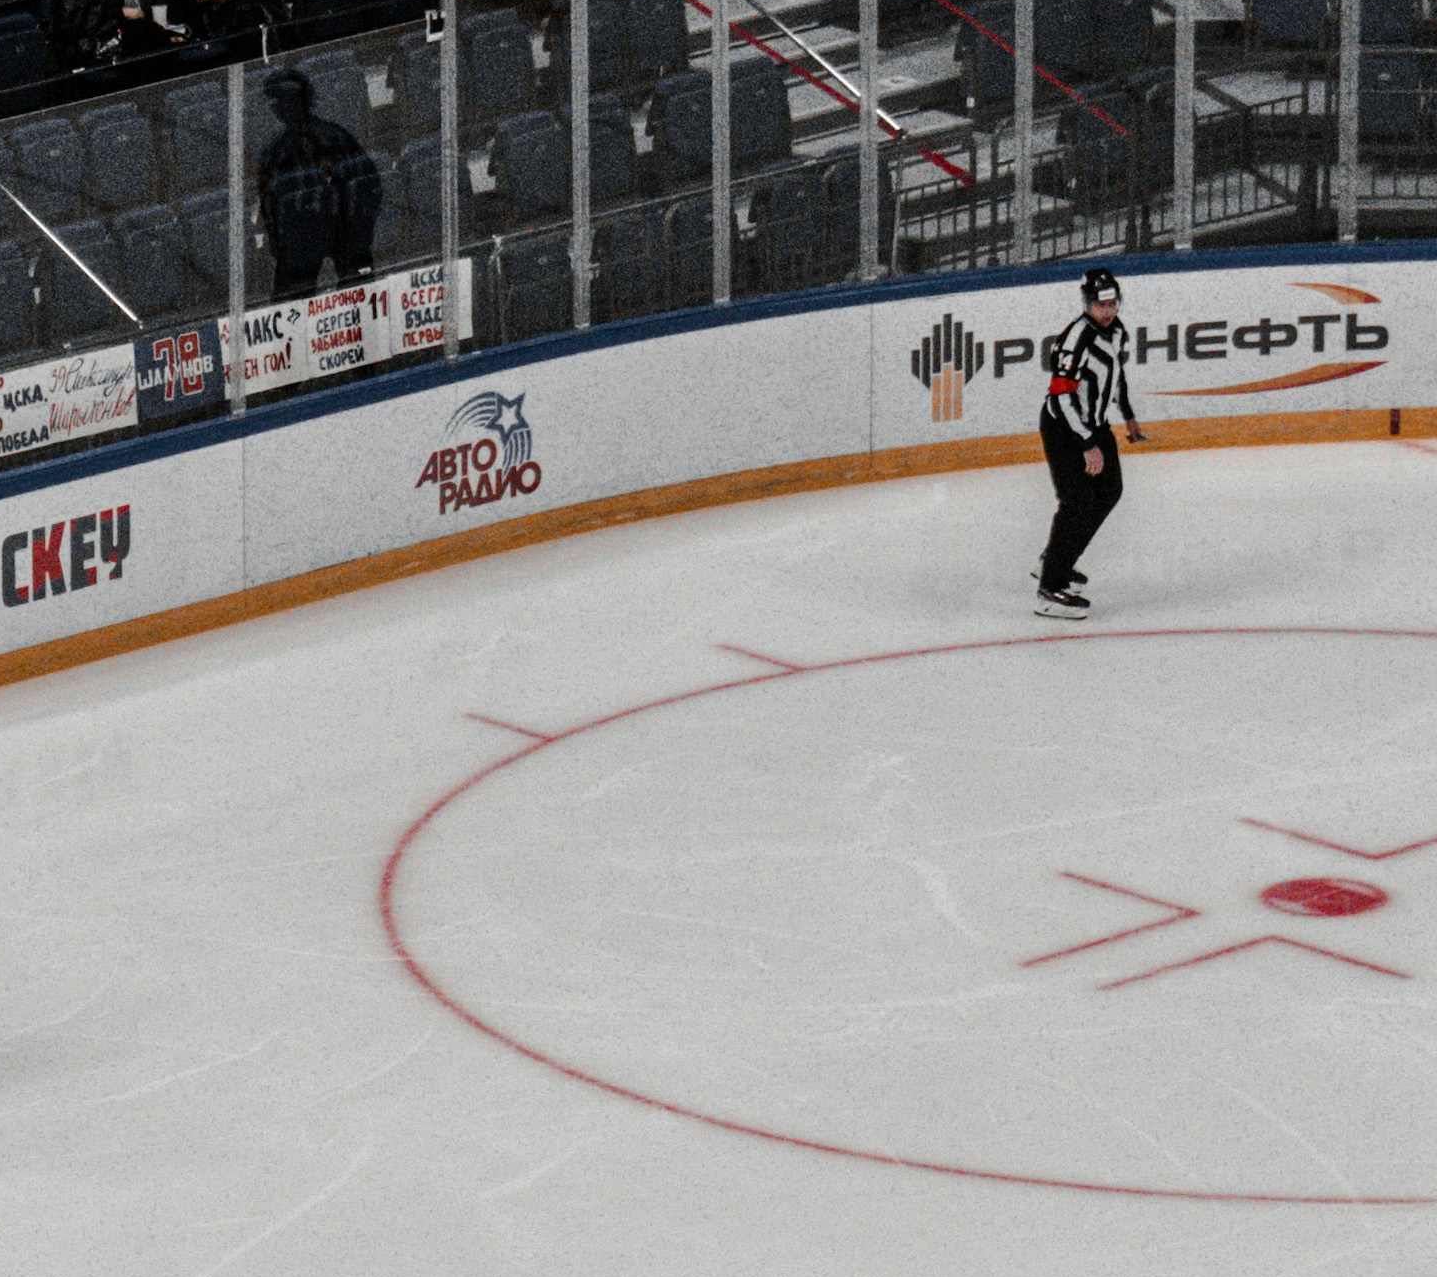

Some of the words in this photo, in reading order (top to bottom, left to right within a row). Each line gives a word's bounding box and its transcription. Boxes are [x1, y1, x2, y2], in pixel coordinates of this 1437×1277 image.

[308, 287, 365, 316] АНДРОНОВ
[401, 287, 443, 310] ВСЕГД
[316, 305, 361, 335] СЕРГЕЙ
[405, 305, 442, 329] БУДЕ
[264, 342, 291, 374] ГОЛ!
[319, 347, 364, 371] СКОРЕЙ
[994, 313, 1389, 378] РНЕФТЬ
[415, 439, 497, 488] АВТО
[440, 461, 541, 514] РАДИО
